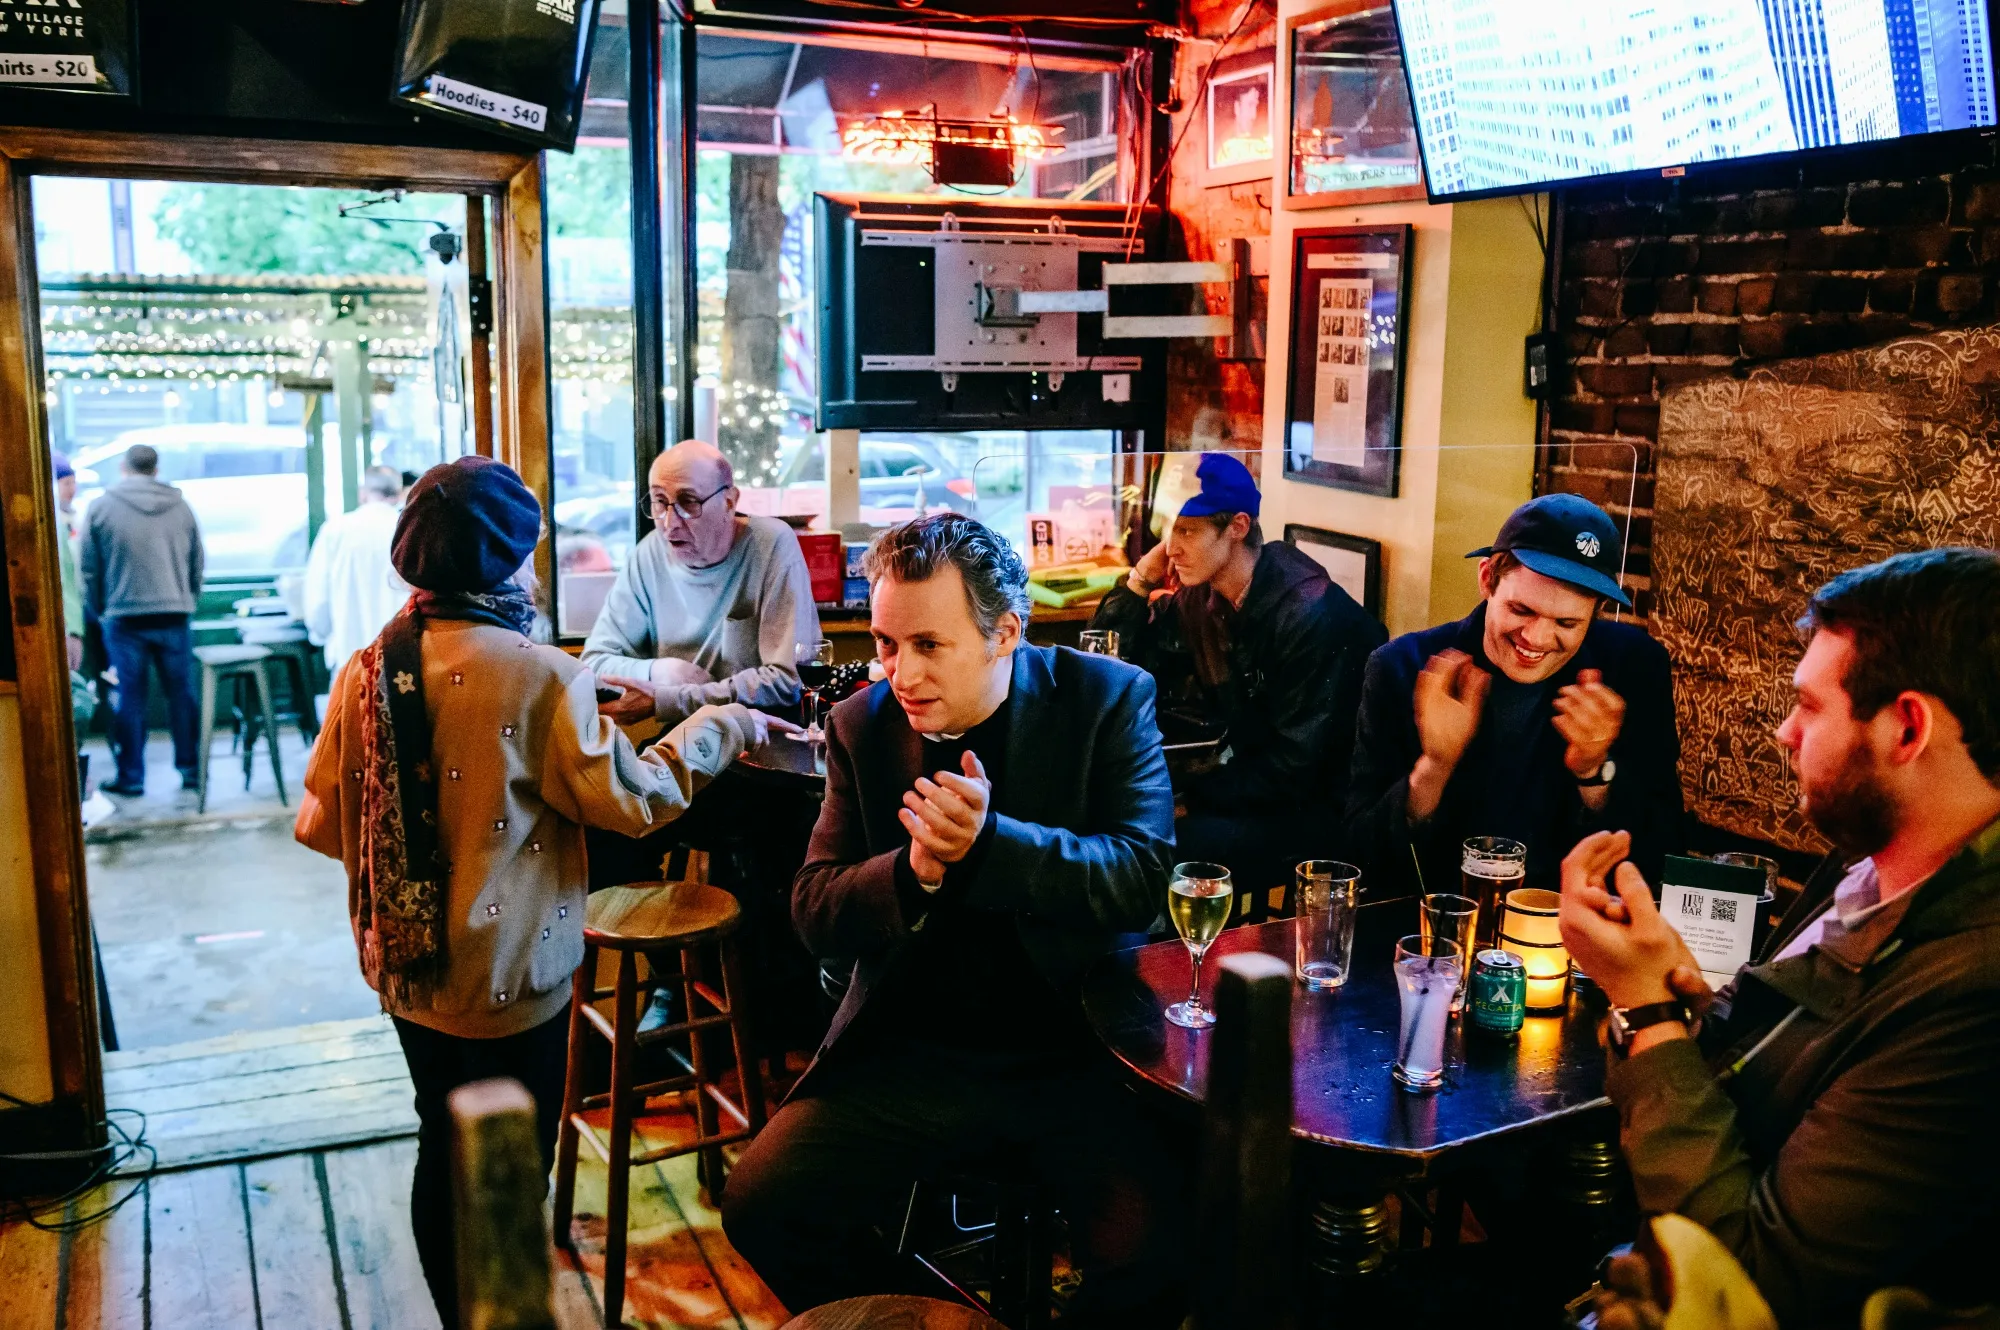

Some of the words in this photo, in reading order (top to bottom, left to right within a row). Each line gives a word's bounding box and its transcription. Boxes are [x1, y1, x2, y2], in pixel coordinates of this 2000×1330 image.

[15, 12, 84, 26] VILLAGE
[26, 24, 84, 38] YORK
[55, 60, 88, 77] $20
[436, 83, 496, 112] Hoodies
[512, 104, 540, 124] $40
[1036, 521, 1049, 562] OSED
[1681, 906, 1702, 916] BAR
[1475, 998, 1522, 1012] REGATTA
